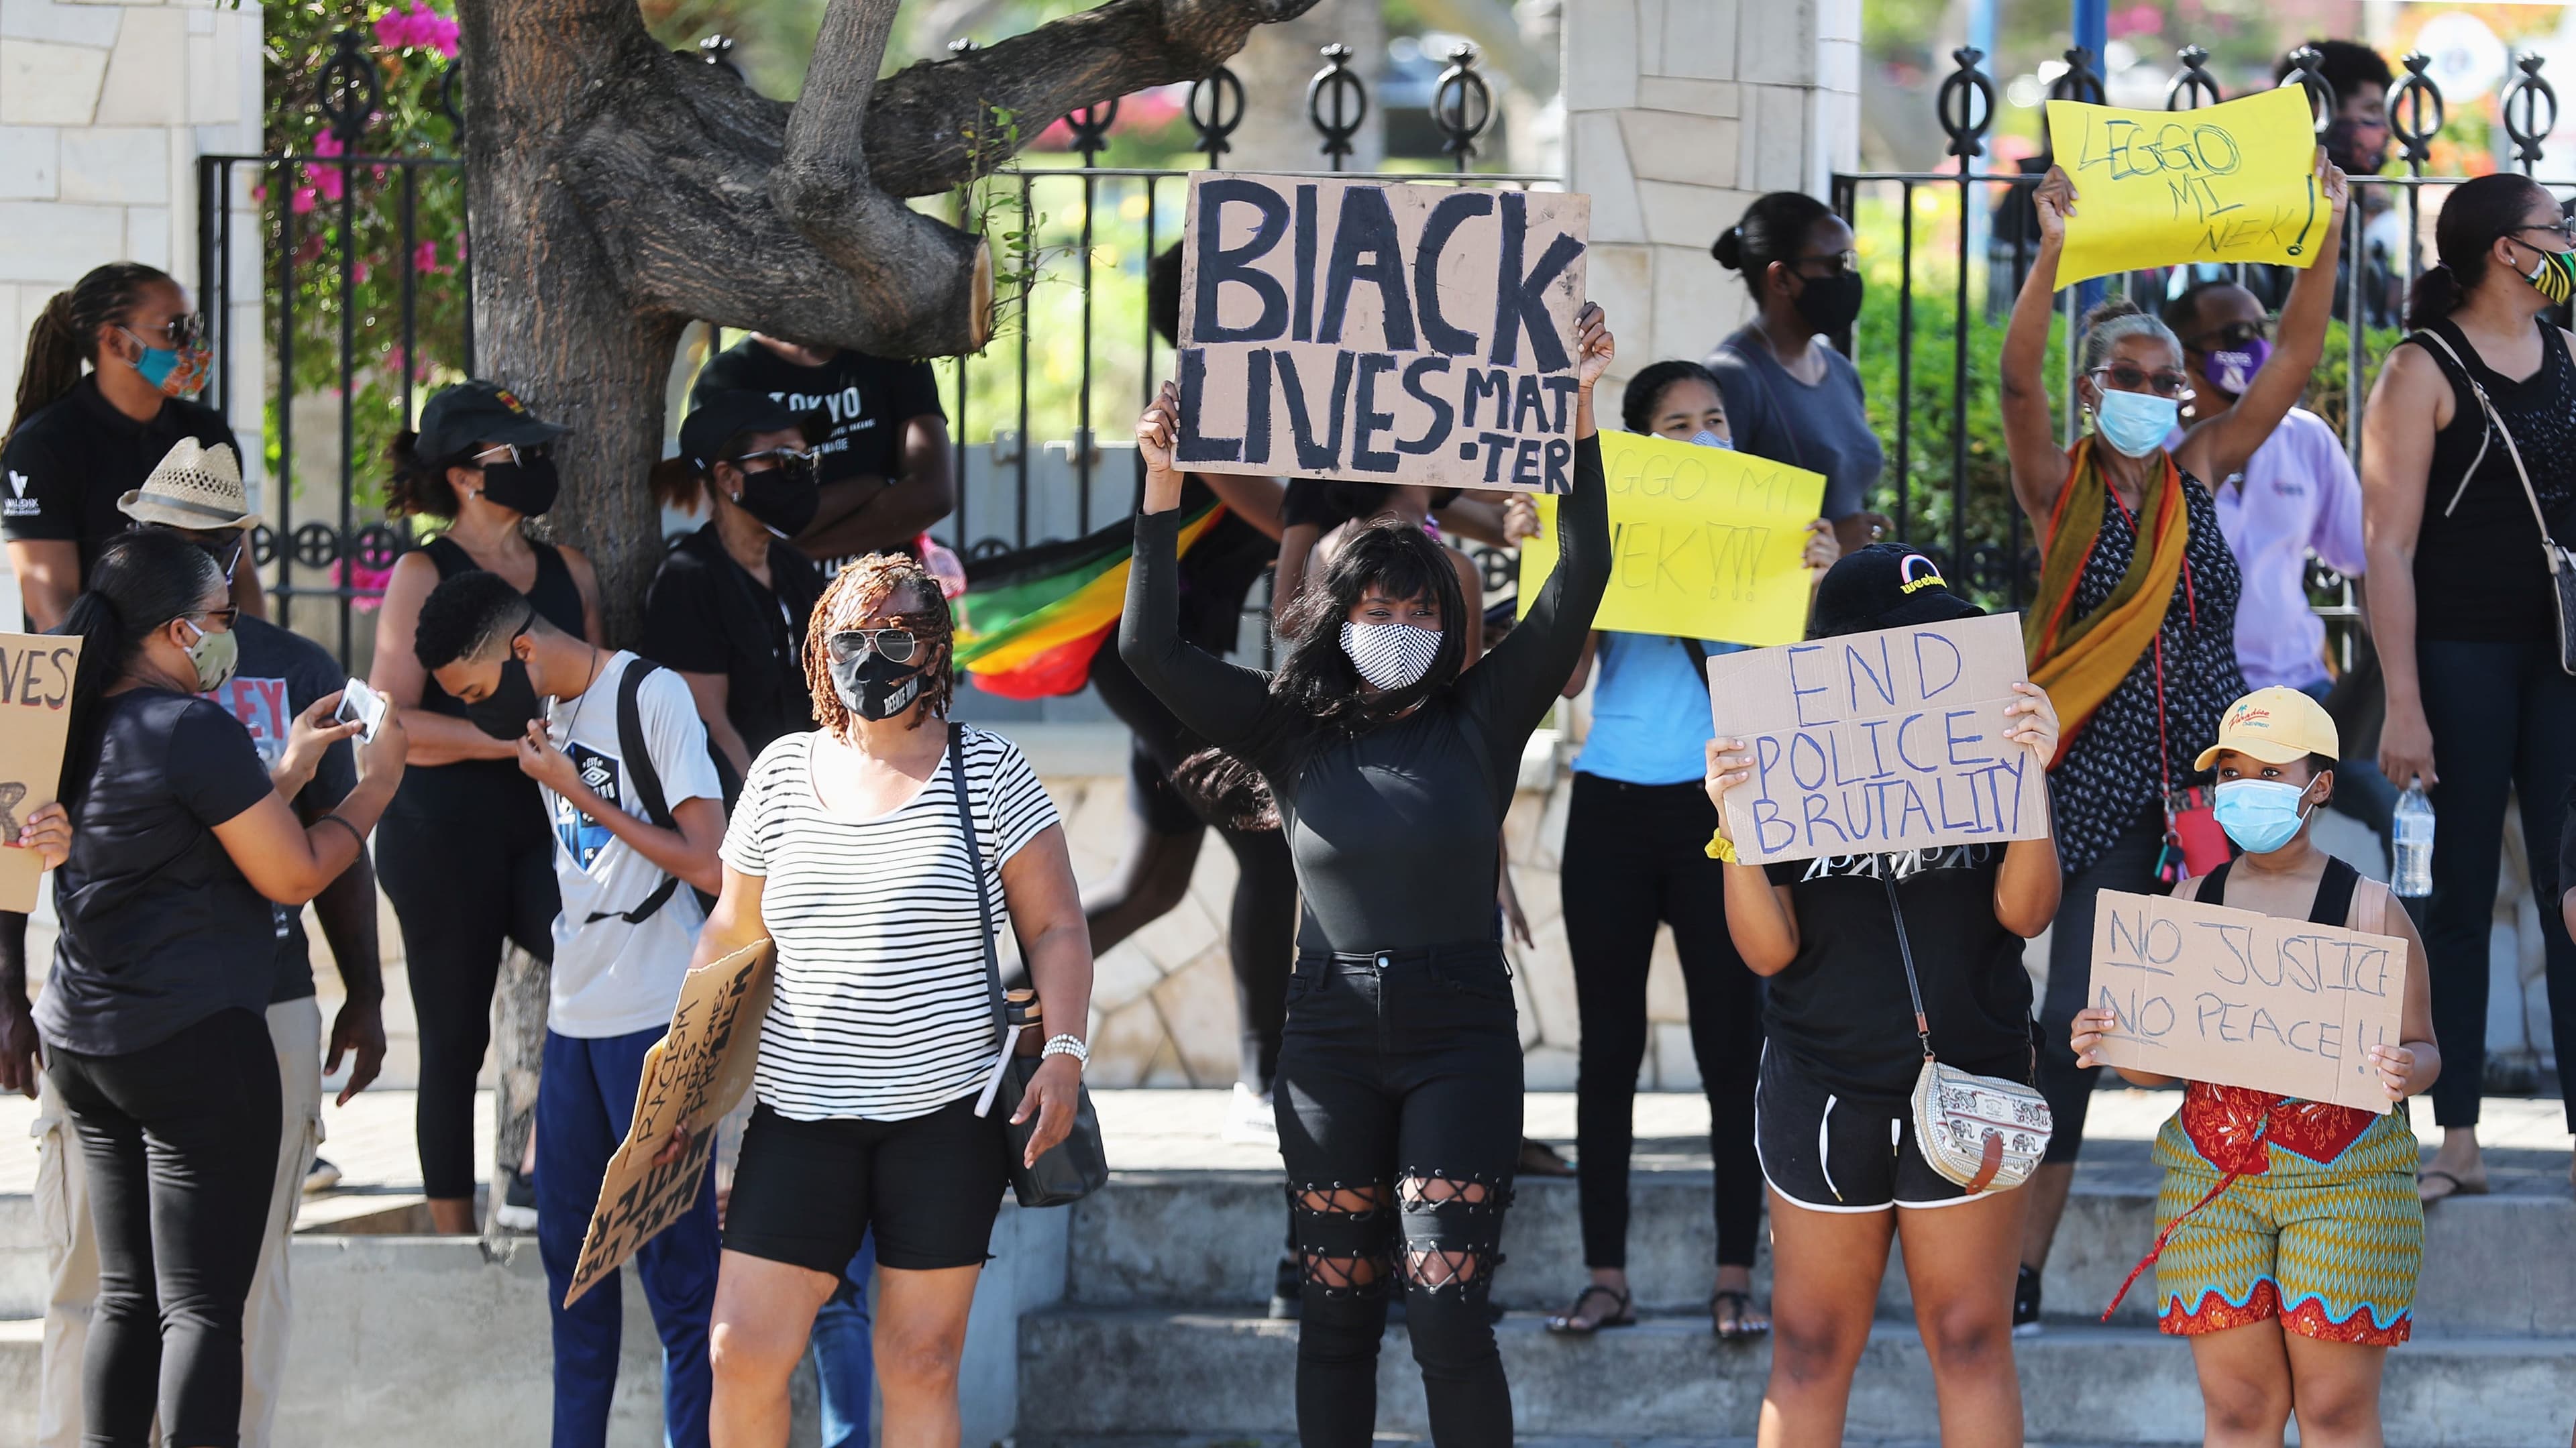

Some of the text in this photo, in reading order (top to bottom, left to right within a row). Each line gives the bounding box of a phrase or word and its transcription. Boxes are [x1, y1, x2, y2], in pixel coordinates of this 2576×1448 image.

[2078, 111, 2241, 180] LEGGO
[2167, 172, 2245, 224] MI
[1175, 347, 1454, 474] LIVES
[1736, 467, 1794, 514] MI
[1788, 632, 1961, 727] END
[1756, 710, 1994, 799] POLICE
[1752, 752, 2025, 854] BRUTALITY
[2112, 909, 2182, 964] NO
[2098, 986, 2176, 1036] NO
[637, 999, 699, 1143] RACISM
[672, 1042, 696, 1093] IS
